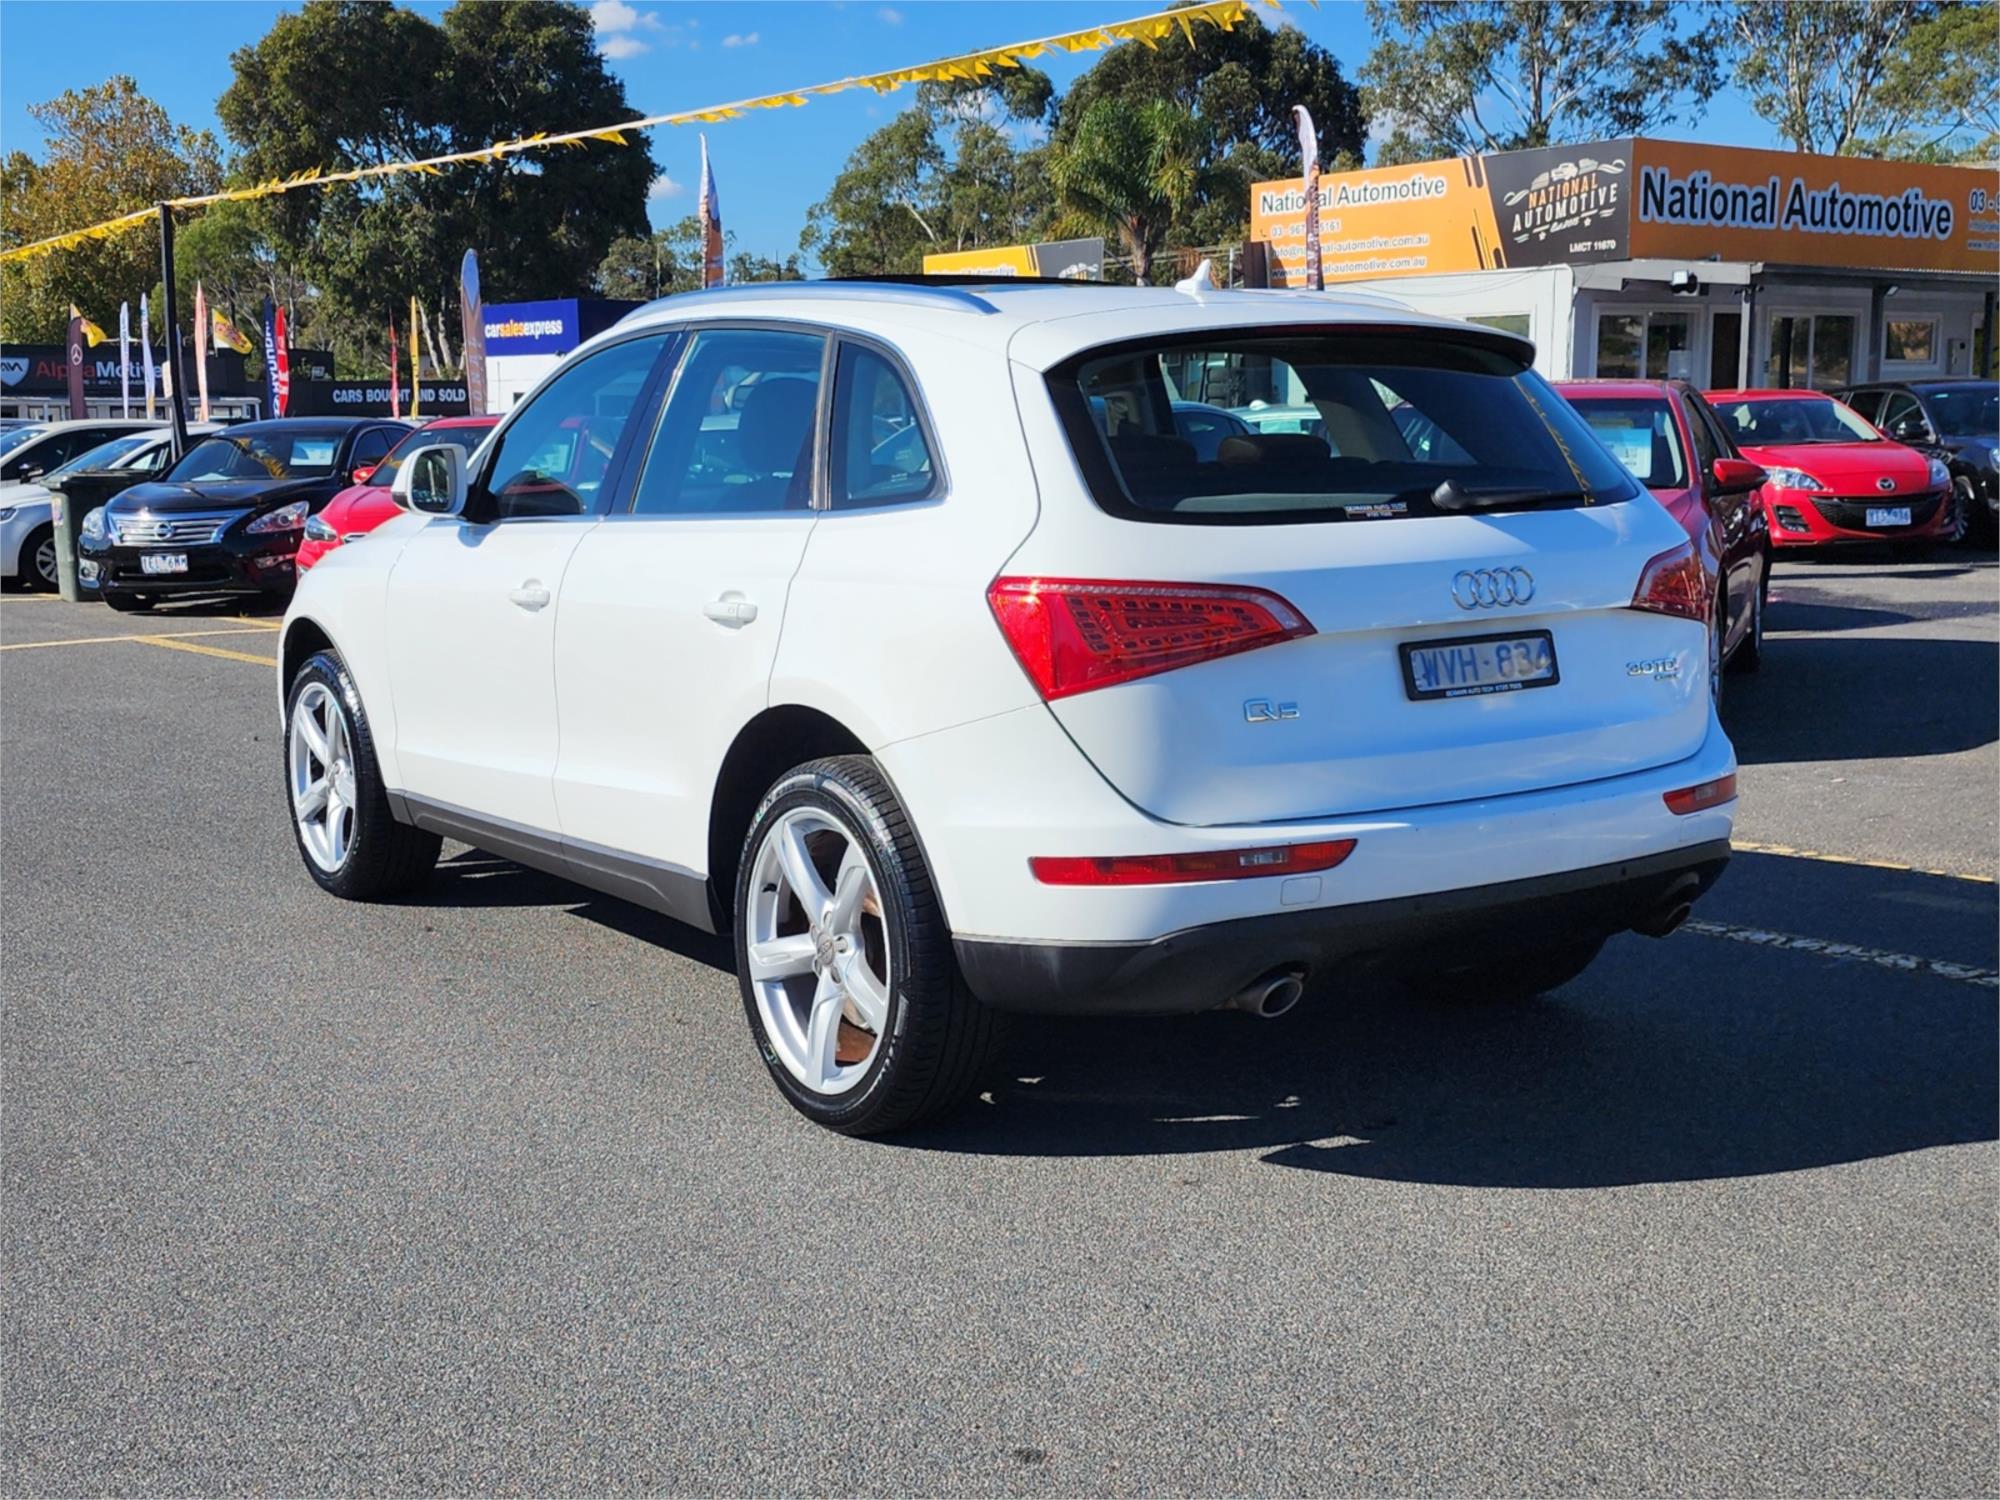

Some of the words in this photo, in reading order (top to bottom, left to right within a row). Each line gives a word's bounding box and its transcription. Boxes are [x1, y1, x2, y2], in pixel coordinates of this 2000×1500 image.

[1261, 186, 1333, 213] Natioal
[1337, 177, 1446, 205] Automotive
[1528, 173, 1598, 209] NATIONAL
[1641, 169, 1778, 225] National
[1783, 181, 1952, 236] Automotive
[1970, 189, 1986, 212] 03
[1512, 183, 1618, 233] AUTOMOTIVE
[484, 319, 564, 340] carsalesexpress
[36, 360, 163, 380] AlpaMotie
[332, 389, 363, 403] CARS
[366, 388, 411, 402] BOUHT
[438, 388, 466, 402] SOLD
[1243, 698, 1300, 722] Q5
